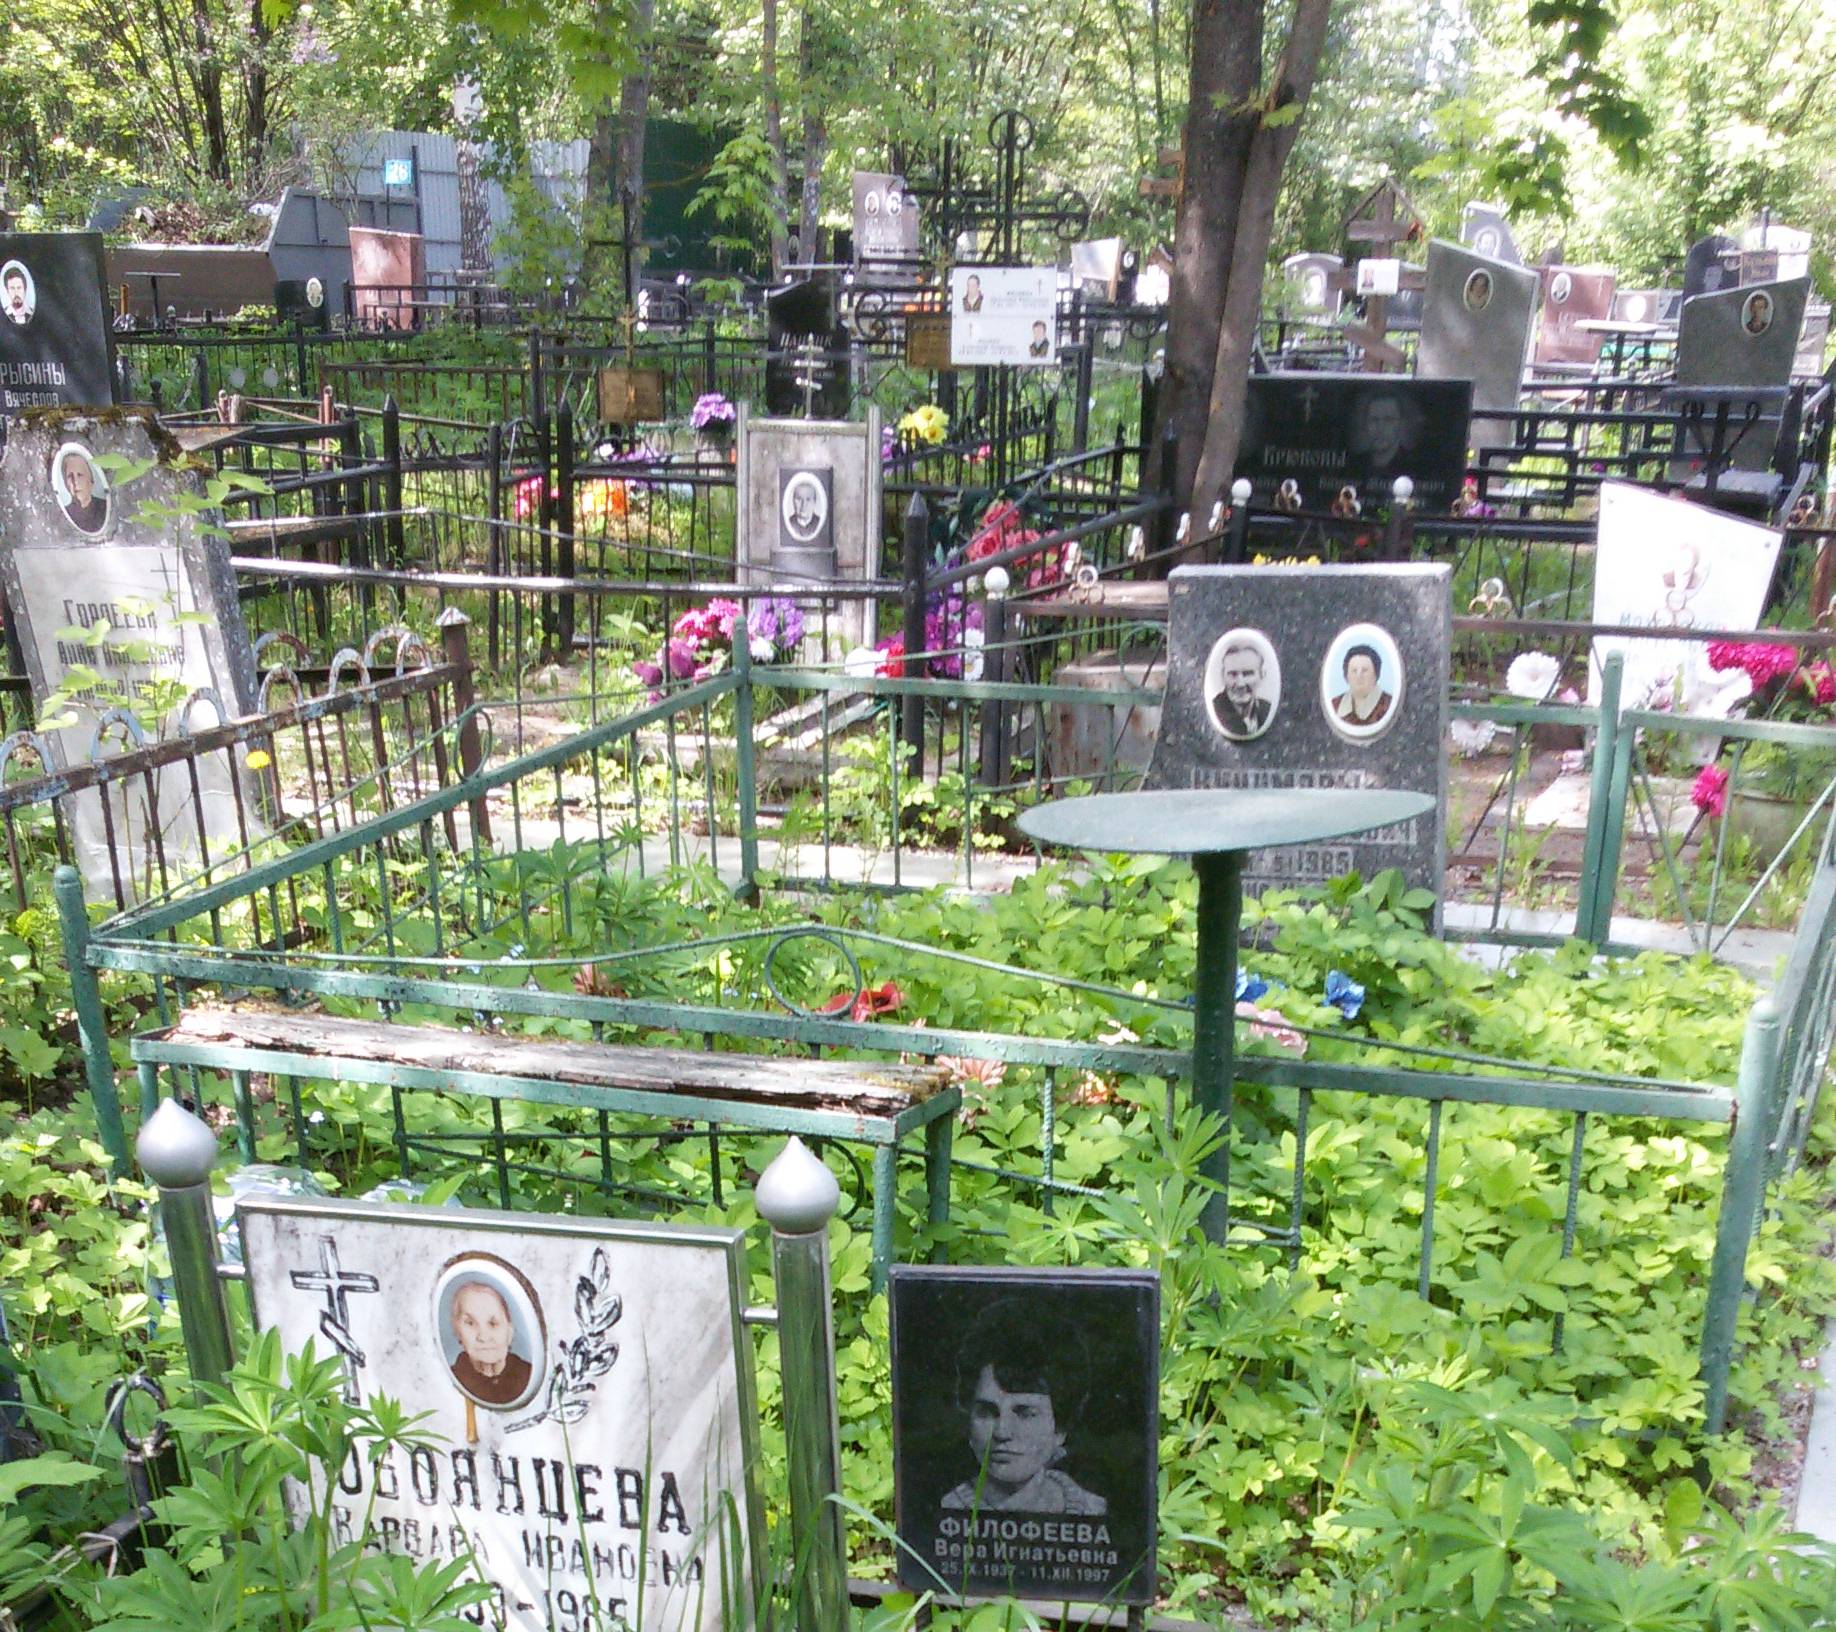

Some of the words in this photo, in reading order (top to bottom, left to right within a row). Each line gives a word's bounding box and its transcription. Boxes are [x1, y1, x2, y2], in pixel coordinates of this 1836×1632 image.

[939, 1516, 1111, 1545] ФИЛОФЕЕВА
[522, 1529, 702, 1587] ИВАНОВНА
[934, 1538, 987, 1561] Вера
[993, 1541, 1119, 1566] Игнатьевна
